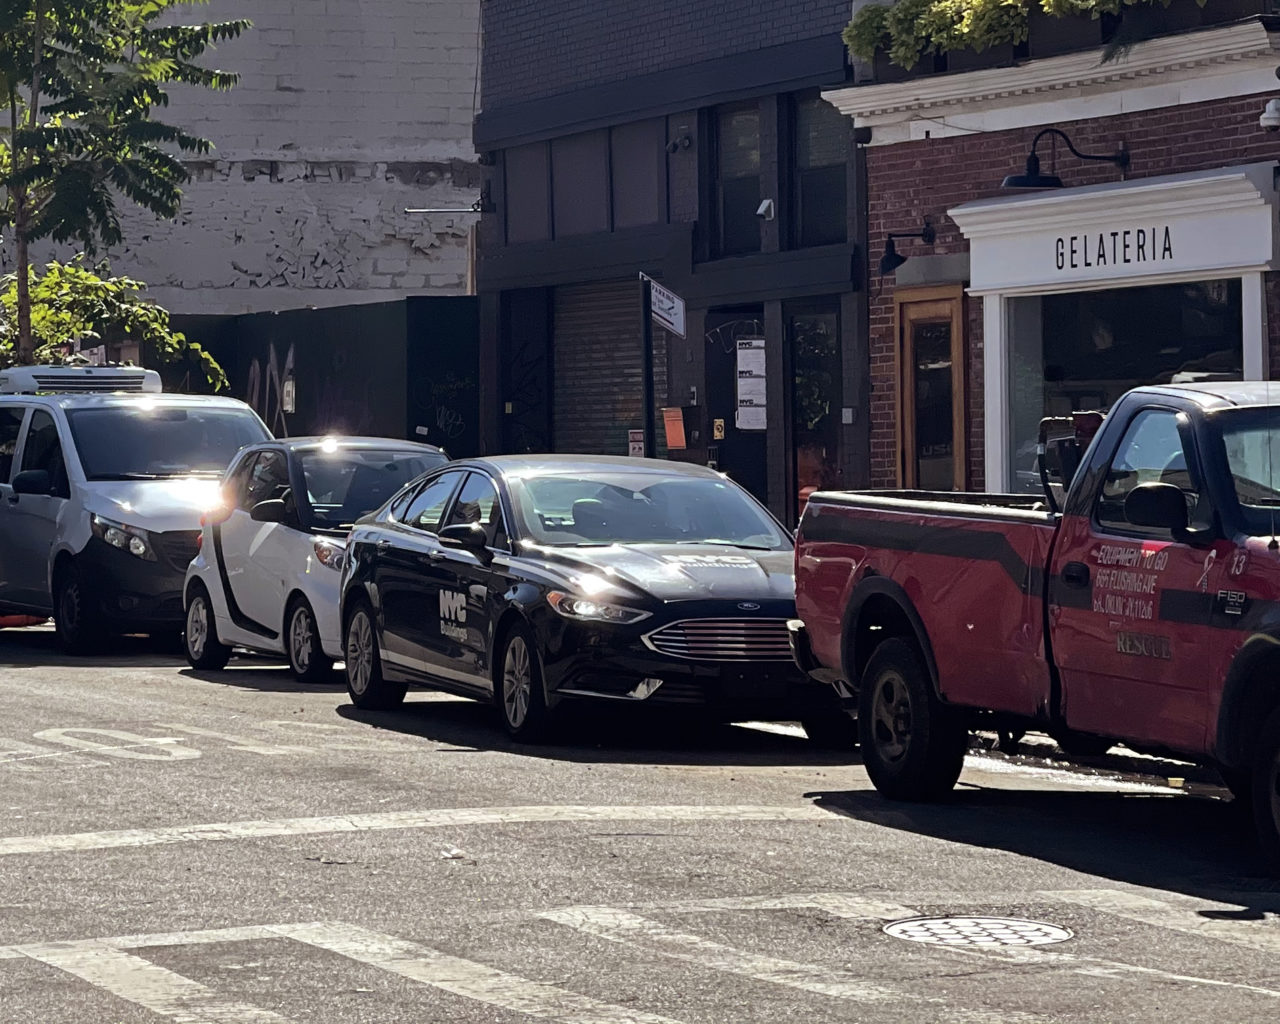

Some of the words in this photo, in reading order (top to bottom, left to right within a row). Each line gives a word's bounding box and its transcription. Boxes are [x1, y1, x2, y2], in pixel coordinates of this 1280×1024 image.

[1055, 226, 1173, 270] GELATERIA
[1097, 545, 1143, 568] EQUIPMENT
[1142, 550, 1155, 570] TO
[1155, 552, 1169, 571] GO
[1231, 555, 1246, 575] 13
[1109, 570, 1142, 592] FLUSHING
[1142, 574, 1158, 594] AVE
[439, 589, 467, 623] NYC
